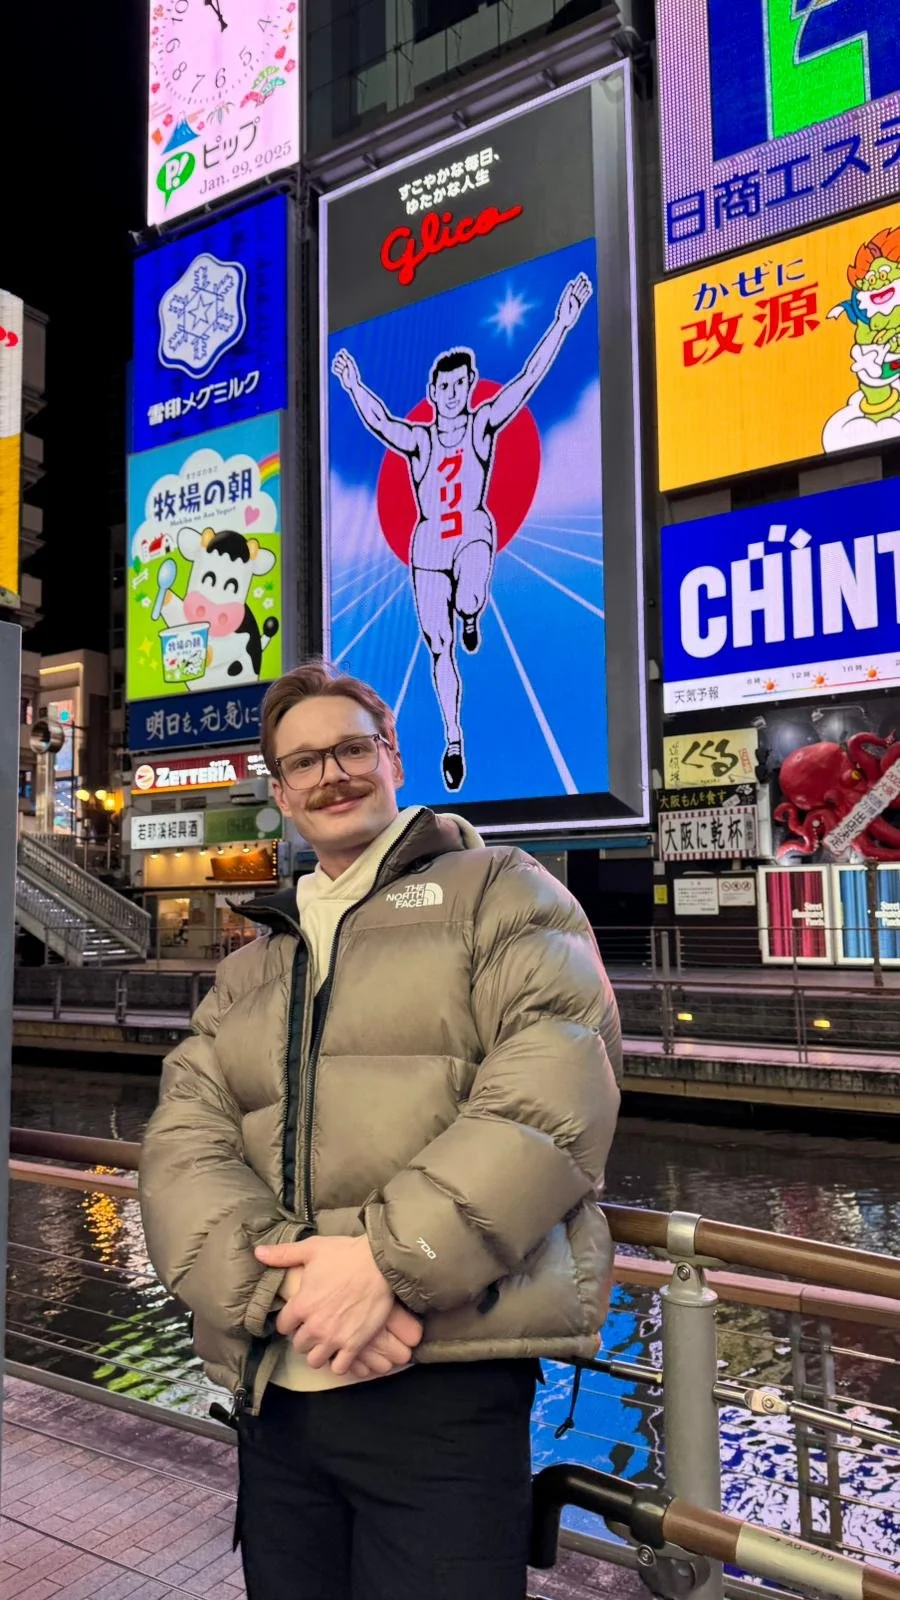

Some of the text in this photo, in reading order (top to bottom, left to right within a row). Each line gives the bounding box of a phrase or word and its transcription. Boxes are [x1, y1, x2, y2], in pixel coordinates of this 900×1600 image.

[172, 61, 188, 81] 8
[191, 74, 206, 93] 7
[214, 68, 226, 89] 6
[203, 115, 261, 169] ピップ
[199, 177, 230, 195] Jan.
[255, 140, 293, 169] 2025
[398, 147, 500, 201] すこやかな毎日、
[406, 168, 491, 215] ゆたかな人生
[380, 203, 524, 286] Glico
[693, 258, 806, 312] かぜに
[680, 281, 821, 368] 改源
[147, 370, 260, 426] 雪印メグミルク
[153, 467, 253, 523] 牧場の朝
[437, 448, 464, 540] グリコ
[674, 685, 719, 705] 天気予報
[681, 738, 739, 778] くくる
[664, 816, 744, 852] 大阪に乾杯
[386, 891, 425, 902] NORTH
[395, 899, 423, 909] FACE
[405, 883, 425, 892] THE
[416, 1236, 437, 1260] 700
